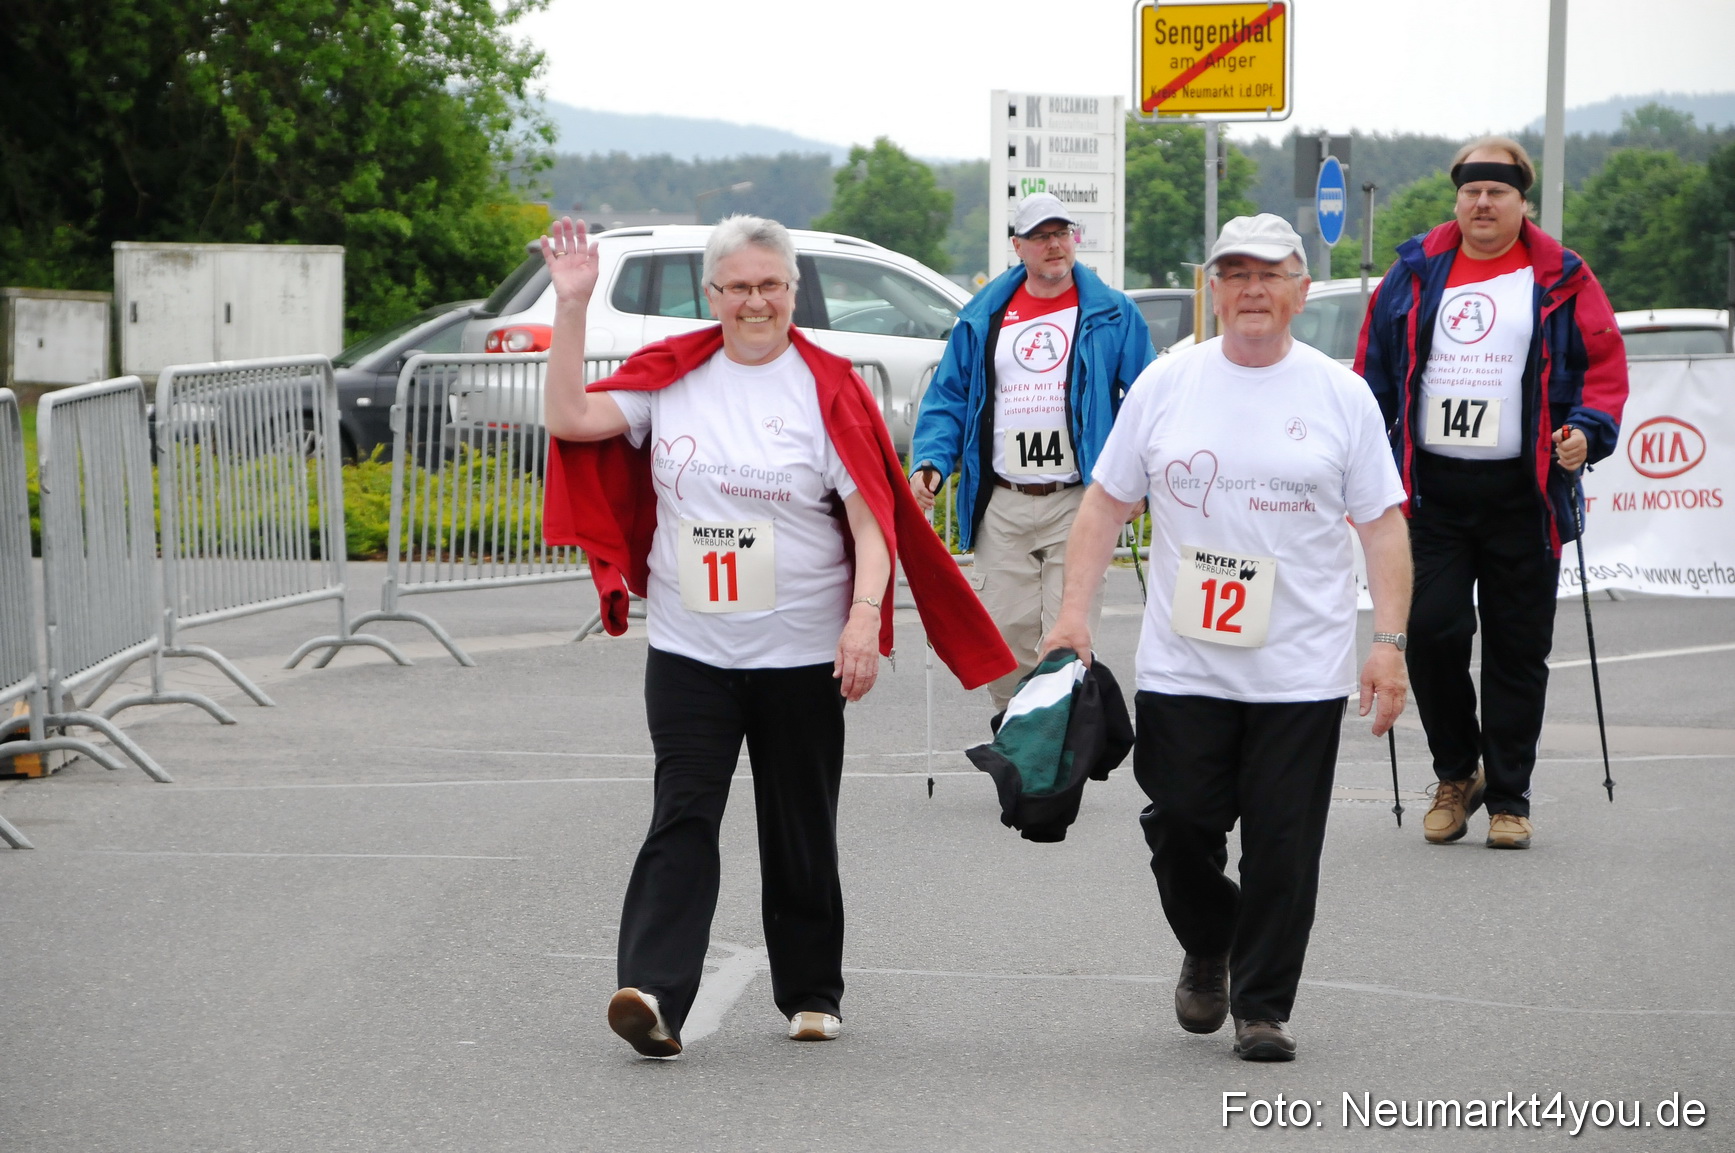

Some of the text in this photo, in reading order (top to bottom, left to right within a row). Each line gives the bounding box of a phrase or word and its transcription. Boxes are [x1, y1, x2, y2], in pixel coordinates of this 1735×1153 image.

[1155, 16, 1272, 51] Sengenthal
[1170, 53, 1256, 73] am Anger
[1151, 85, 1177, 99] Kreis
[1182, 85, 1234, 98] Neumarkt
[1048, 96, 1099, 115] HOLZAMMER
[1048, 136, 1099, 154] HOLZAMMER
[1428, 353, 1514, 362] AUFEN MIT HERZ
[1000, 383, 1030, 394] LAUFEN
[1428, 377, 1502, 387] Leistungsdiagnostik
[1004, 406, 1066, 416] Leistungsdiagnos
[1441, 398, 1488, 438] 147
[1016, 430, 1064, 468] 144
[1640, 432, 1690, 464] KIA
[689, 459, 728, 476] Sport
[740, 464, 792, 485] Gruppe
[720, 482, 792, 502] Neumarkt
[1172, 476, 1200, 490] Herz
[1216, 476, 1256, 492] Sport
[1269, 477, 1318, 496] Gruppe
[1612, 492, 1636, 511] KIA
[1642, 488, 1724, 510] MOTORS
[692, 526, 735, 538] MEYER
[692, 538, 736, 547] WERBUNG
[1195, 562, 1236, 577] WERBUNG
[1196, 552, 1237, 568] MEYER
[702, 551, 738, 602] 11
[1201, 578, 1246, 634] 12
